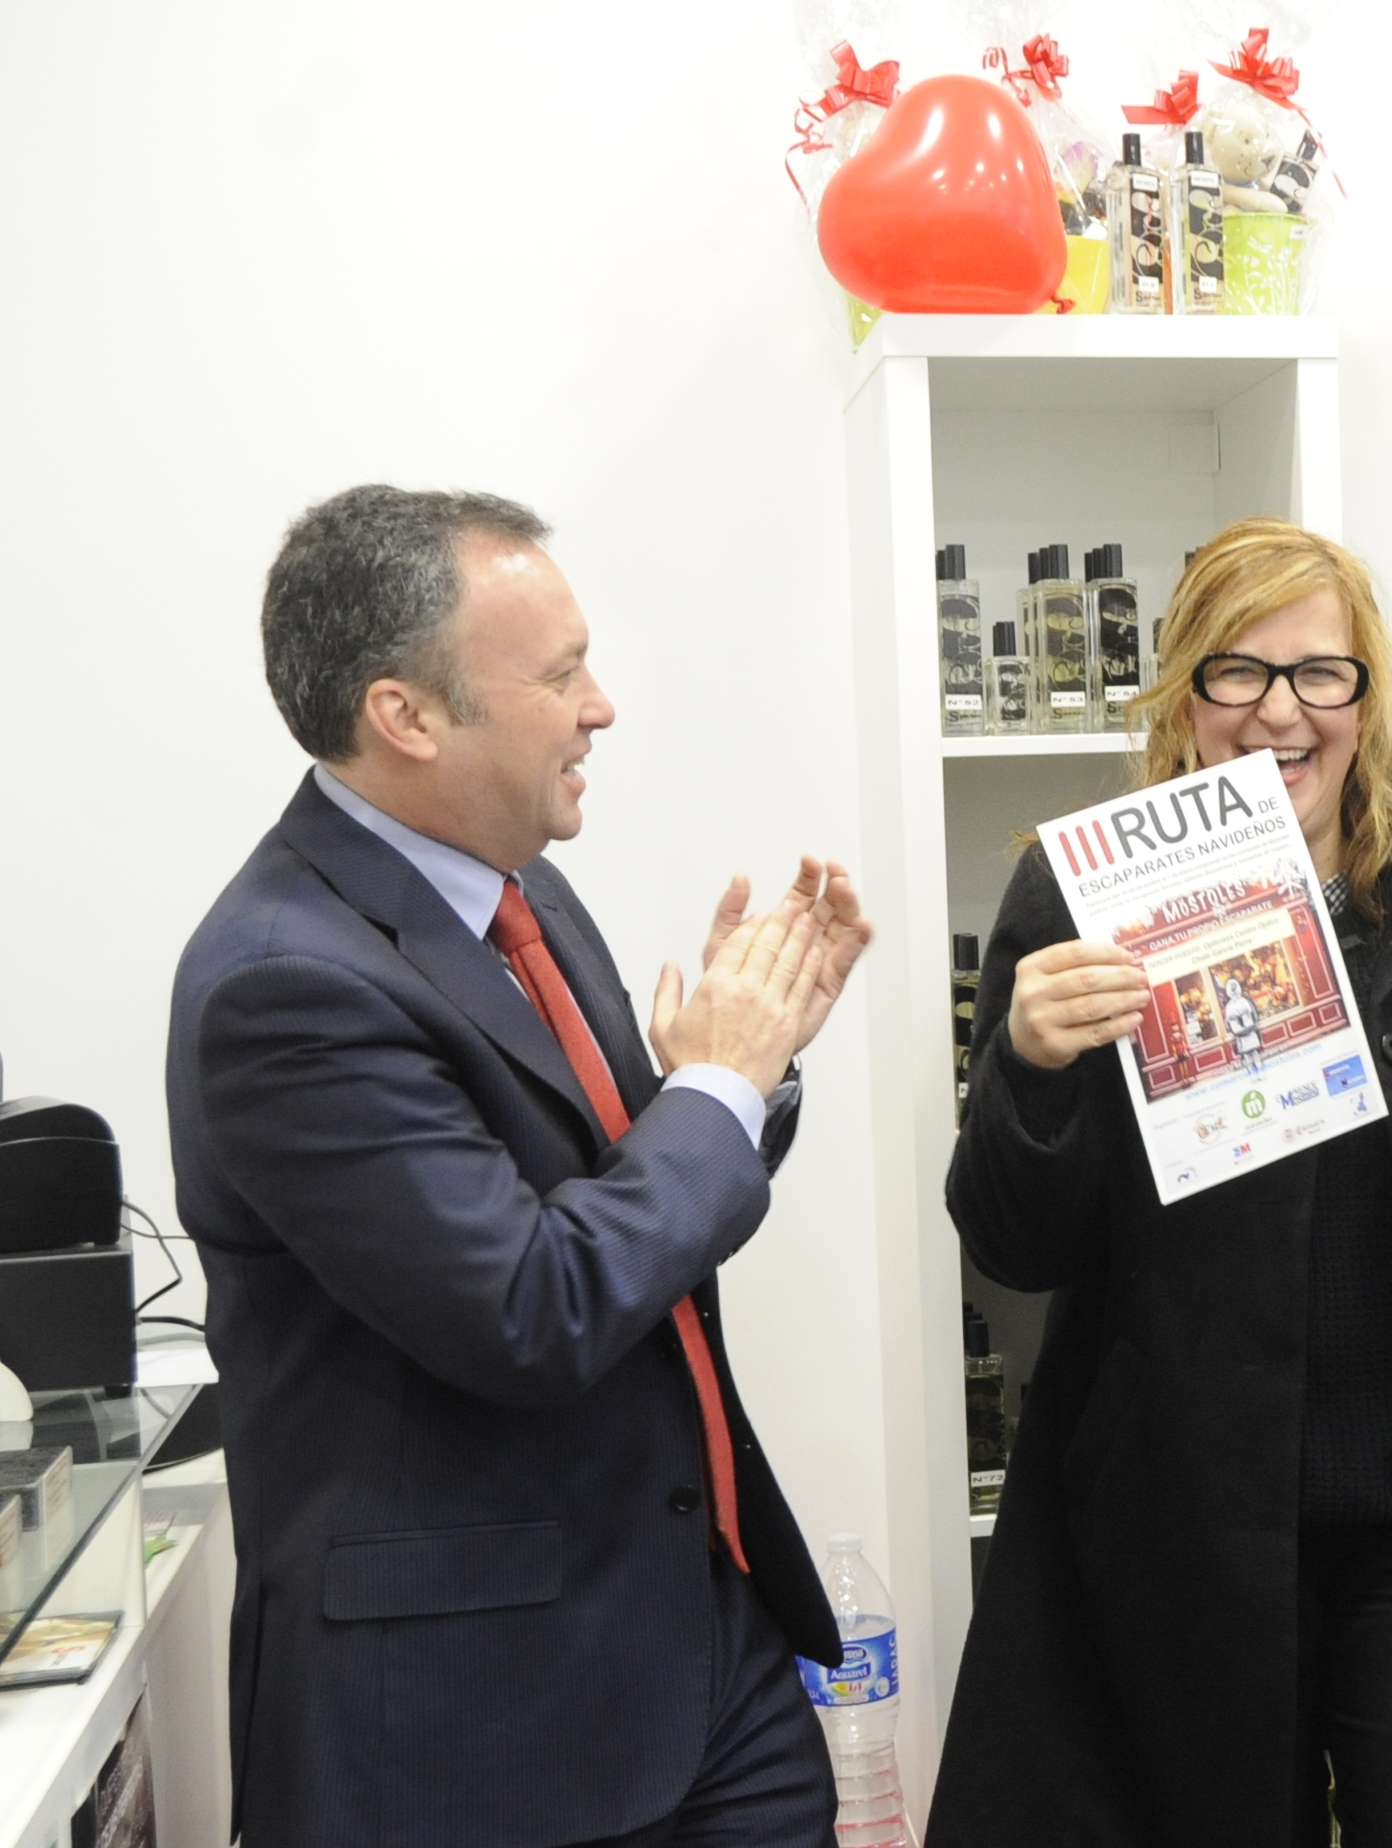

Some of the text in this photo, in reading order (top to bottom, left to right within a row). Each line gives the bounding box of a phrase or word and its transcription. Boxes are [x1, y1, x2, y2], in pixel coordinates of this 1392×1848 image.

[1058, 775, 1277, 876] III RUTA DE
[1078, 816, 1285, 897] ESCAPARATES NAVIDEÑOS
[1148, 898, 1274, 953] GANA TU PROPIO ESCAPARATE
